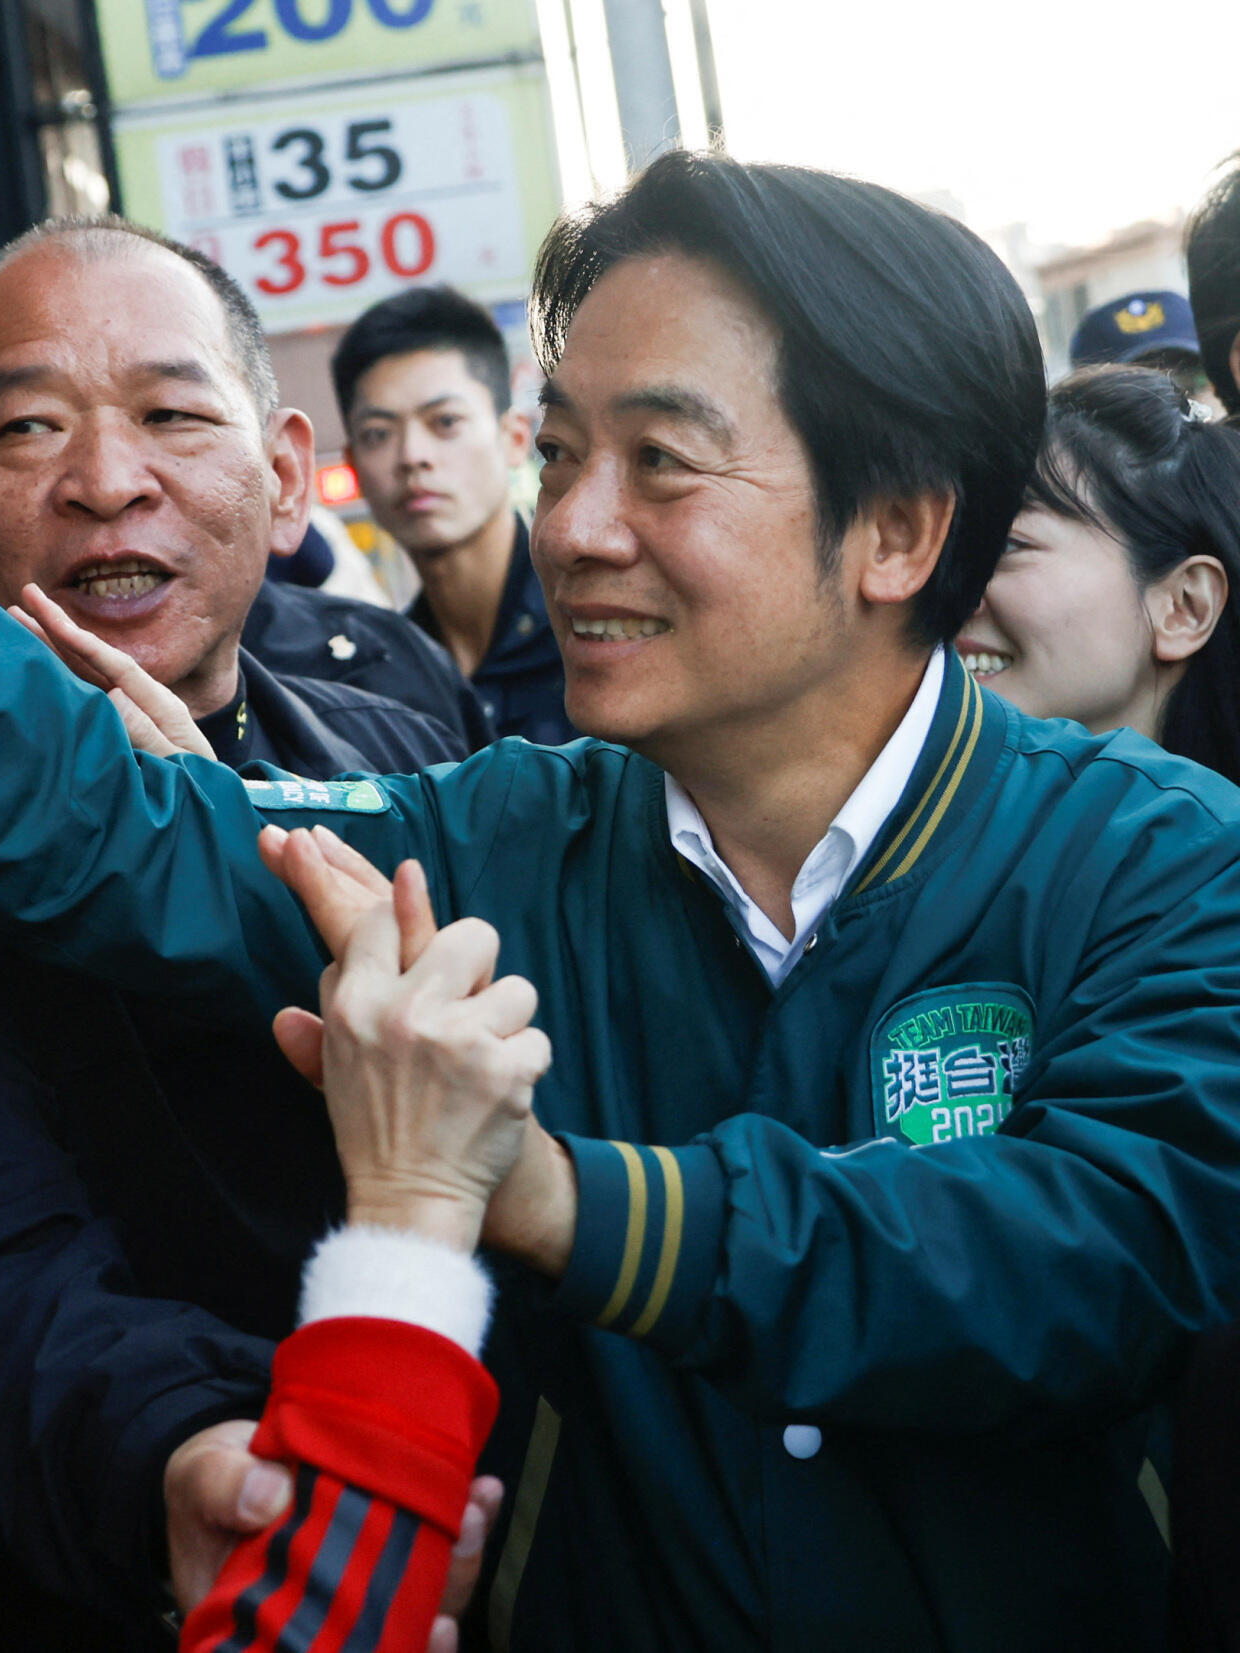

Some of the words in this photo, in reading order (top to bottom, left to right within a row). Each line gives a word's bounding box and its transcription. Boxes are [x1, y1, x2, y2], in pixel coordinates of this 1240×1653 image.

[272, 119, 402, 200] 35
[253, 211, 436, 294] 350
[887, 1006, 956, 1050] TEAM
